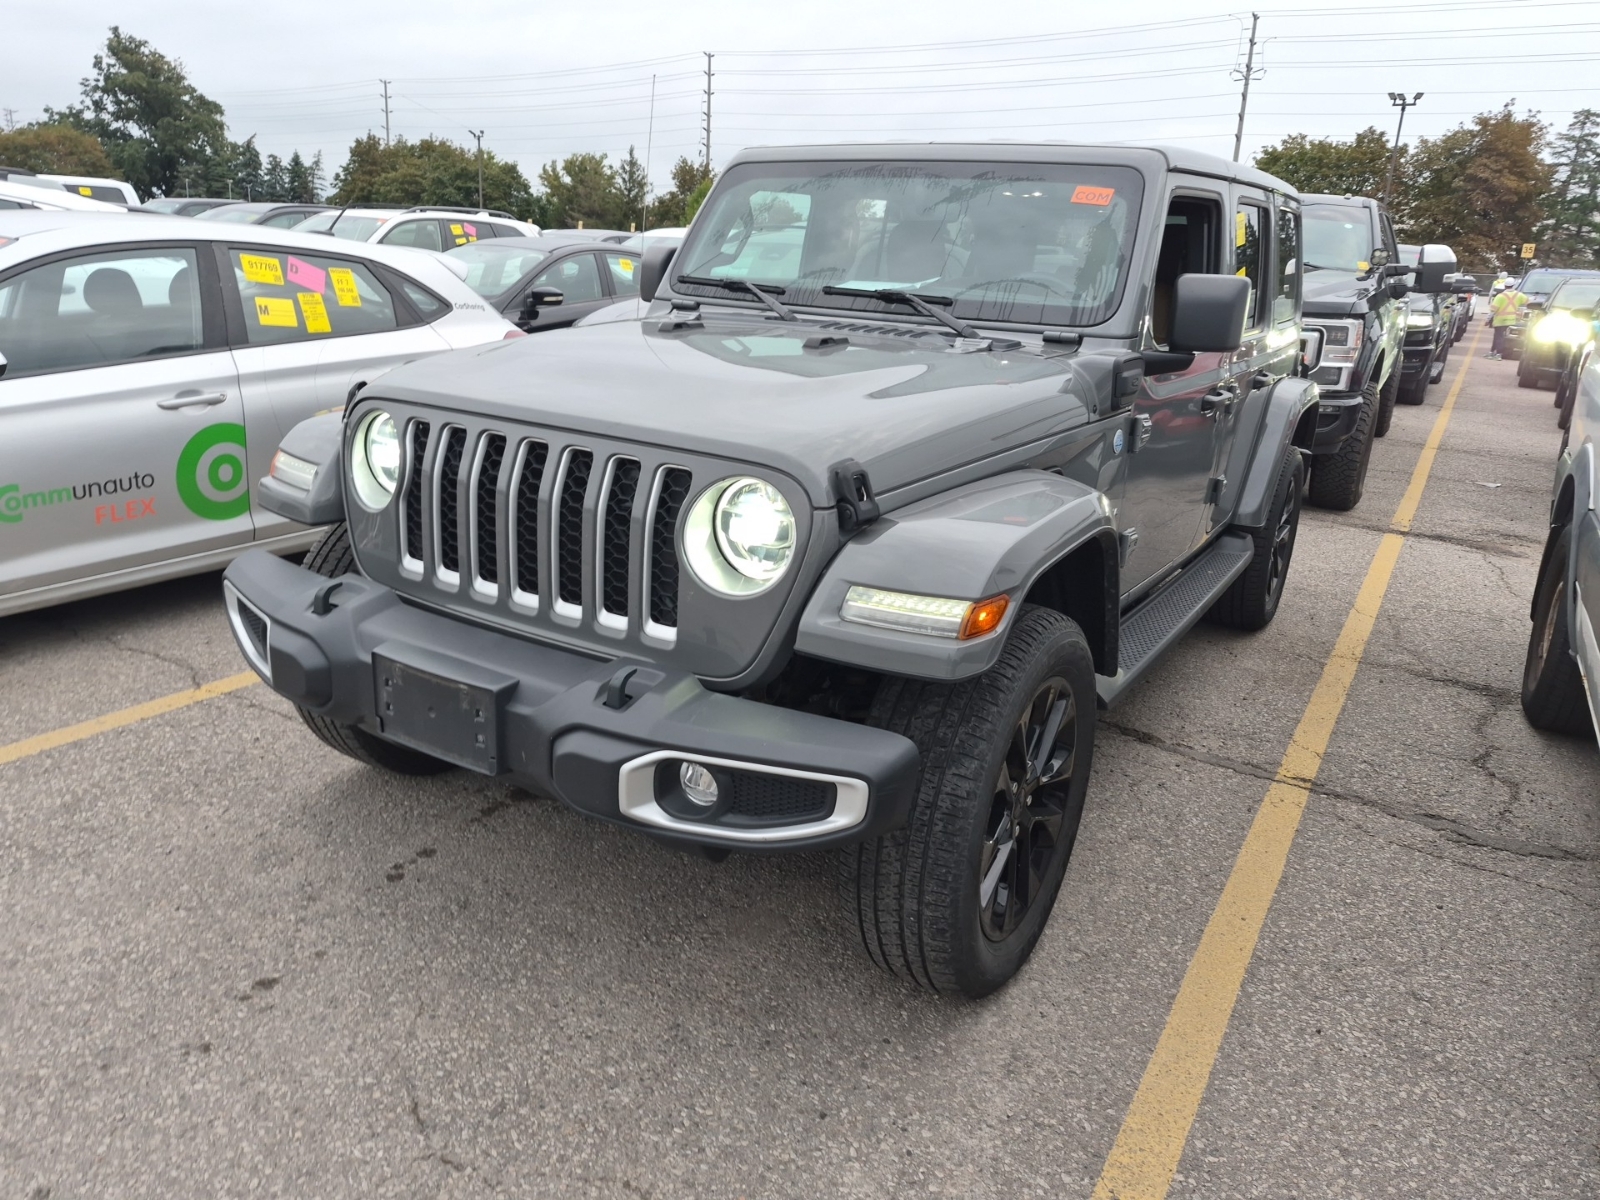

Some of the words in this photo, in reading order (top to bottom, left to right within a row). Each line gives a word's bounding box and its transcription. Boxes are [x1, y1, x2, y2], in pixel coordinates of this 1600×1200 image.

[1075, 191, 1110, 203] COM
[1523, 246, 1533, 254] 35
[289, 263, 299, 274] D
[258, 304, 270, 316] M
[454, 302, 486, 312] CarSharing
[94, 496, 157, 526] FLEX
